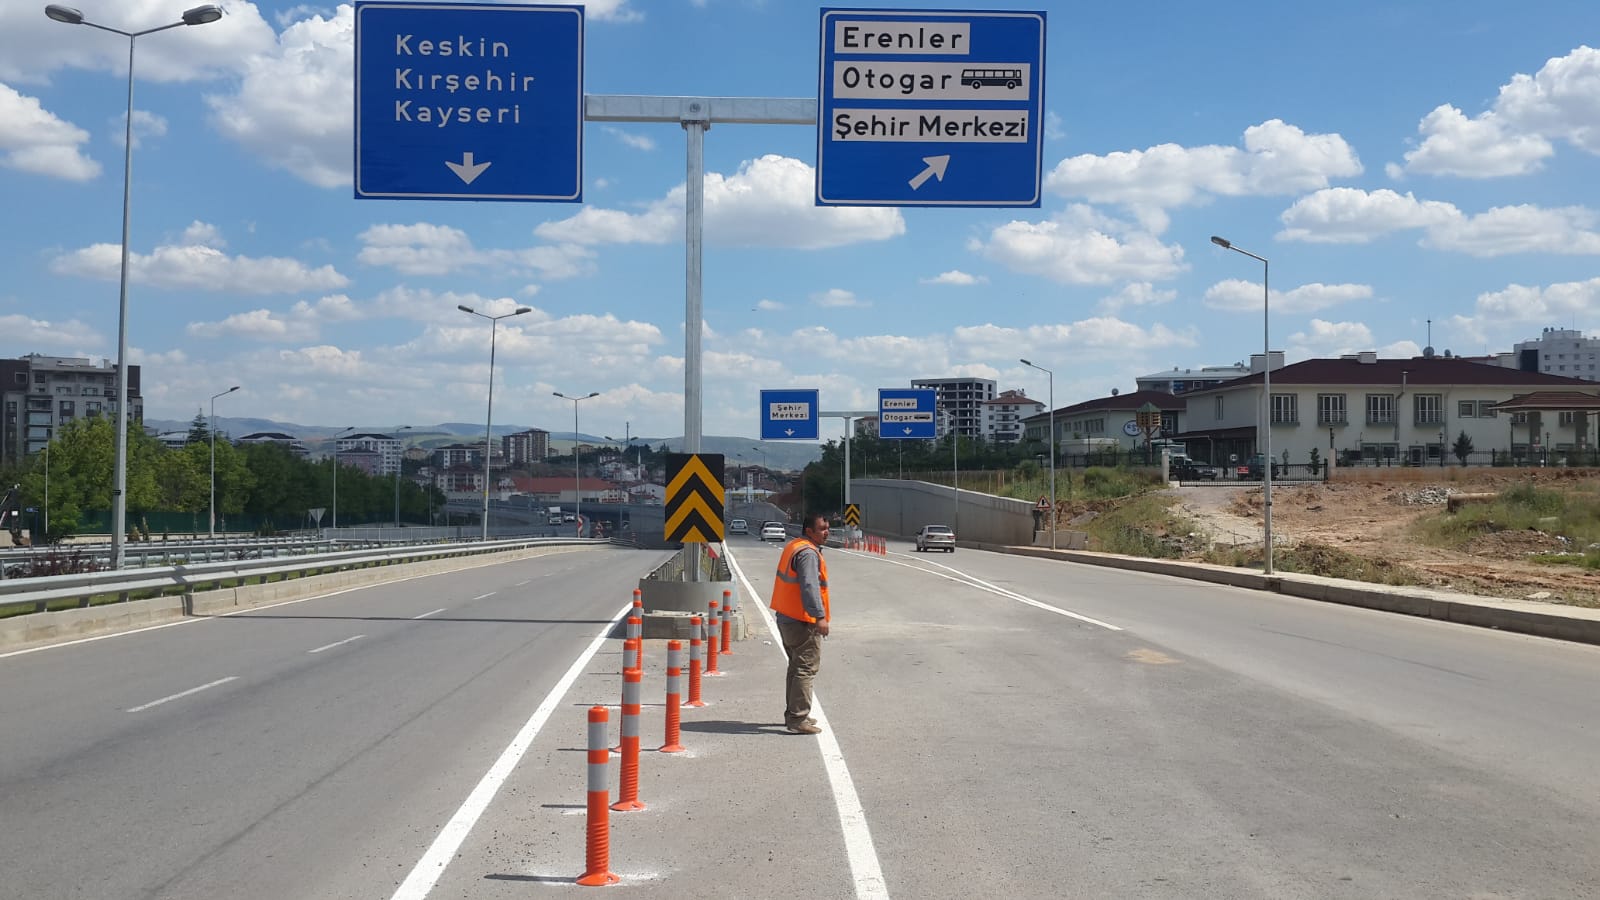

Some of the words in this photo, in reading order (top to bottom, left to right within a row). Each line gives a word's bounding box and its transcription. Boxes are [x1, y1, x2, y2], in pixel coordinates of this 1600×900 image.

[396, 34, 509, 57] Keskin
[843, 27, 962, 49] Erenler
[395, 68, 535, 93] Kırşehir
[842, 66, 952, 95] Otogar
[395, 100, 520, 128] Kayseri
[835, 114, 910, 140] Şehir
[919, 115, 1026, 137] Merkezi
[777, 404, 802, 412] Şehir
